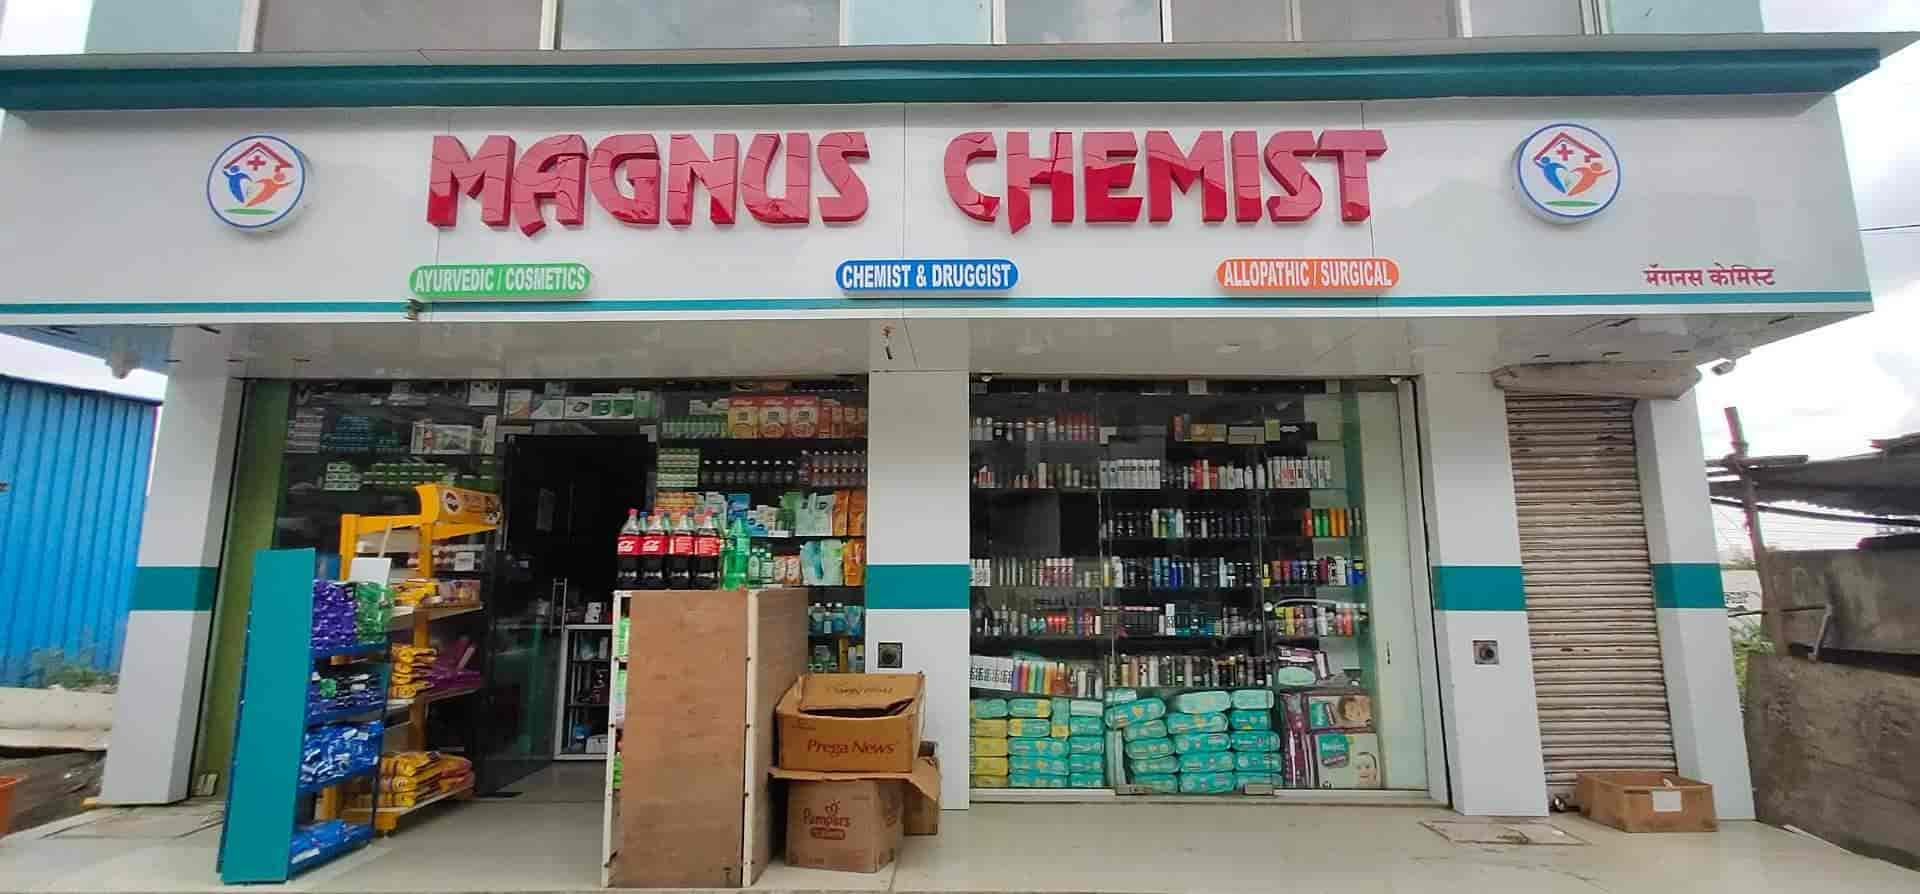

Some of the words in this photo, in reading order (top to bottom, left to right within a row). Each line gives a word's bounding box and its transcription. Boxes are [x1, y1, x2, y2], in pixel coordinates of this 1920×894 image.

[427, 132, 870, 237] MAGNUS
[943, 129, 1388, 234] CHEMIST
[415, 268, 495, 292] AYURVEDIC
[505, 266, 585, 291] COSMETICS
[842, 263, 911, 288] CHEMIST
[915, 264, 927, 287] &
[932, 263, 1011, 288] DRUGGIST
[1223, 260, 1310, 287] ALLOPATHIC
[1320, 260, 1393, 286] SURGICAL
[1707, 262, 1776, 286] केमिस्ट
[807, 738, 849, 758] Prega
[851, 740, 896, 753] News
